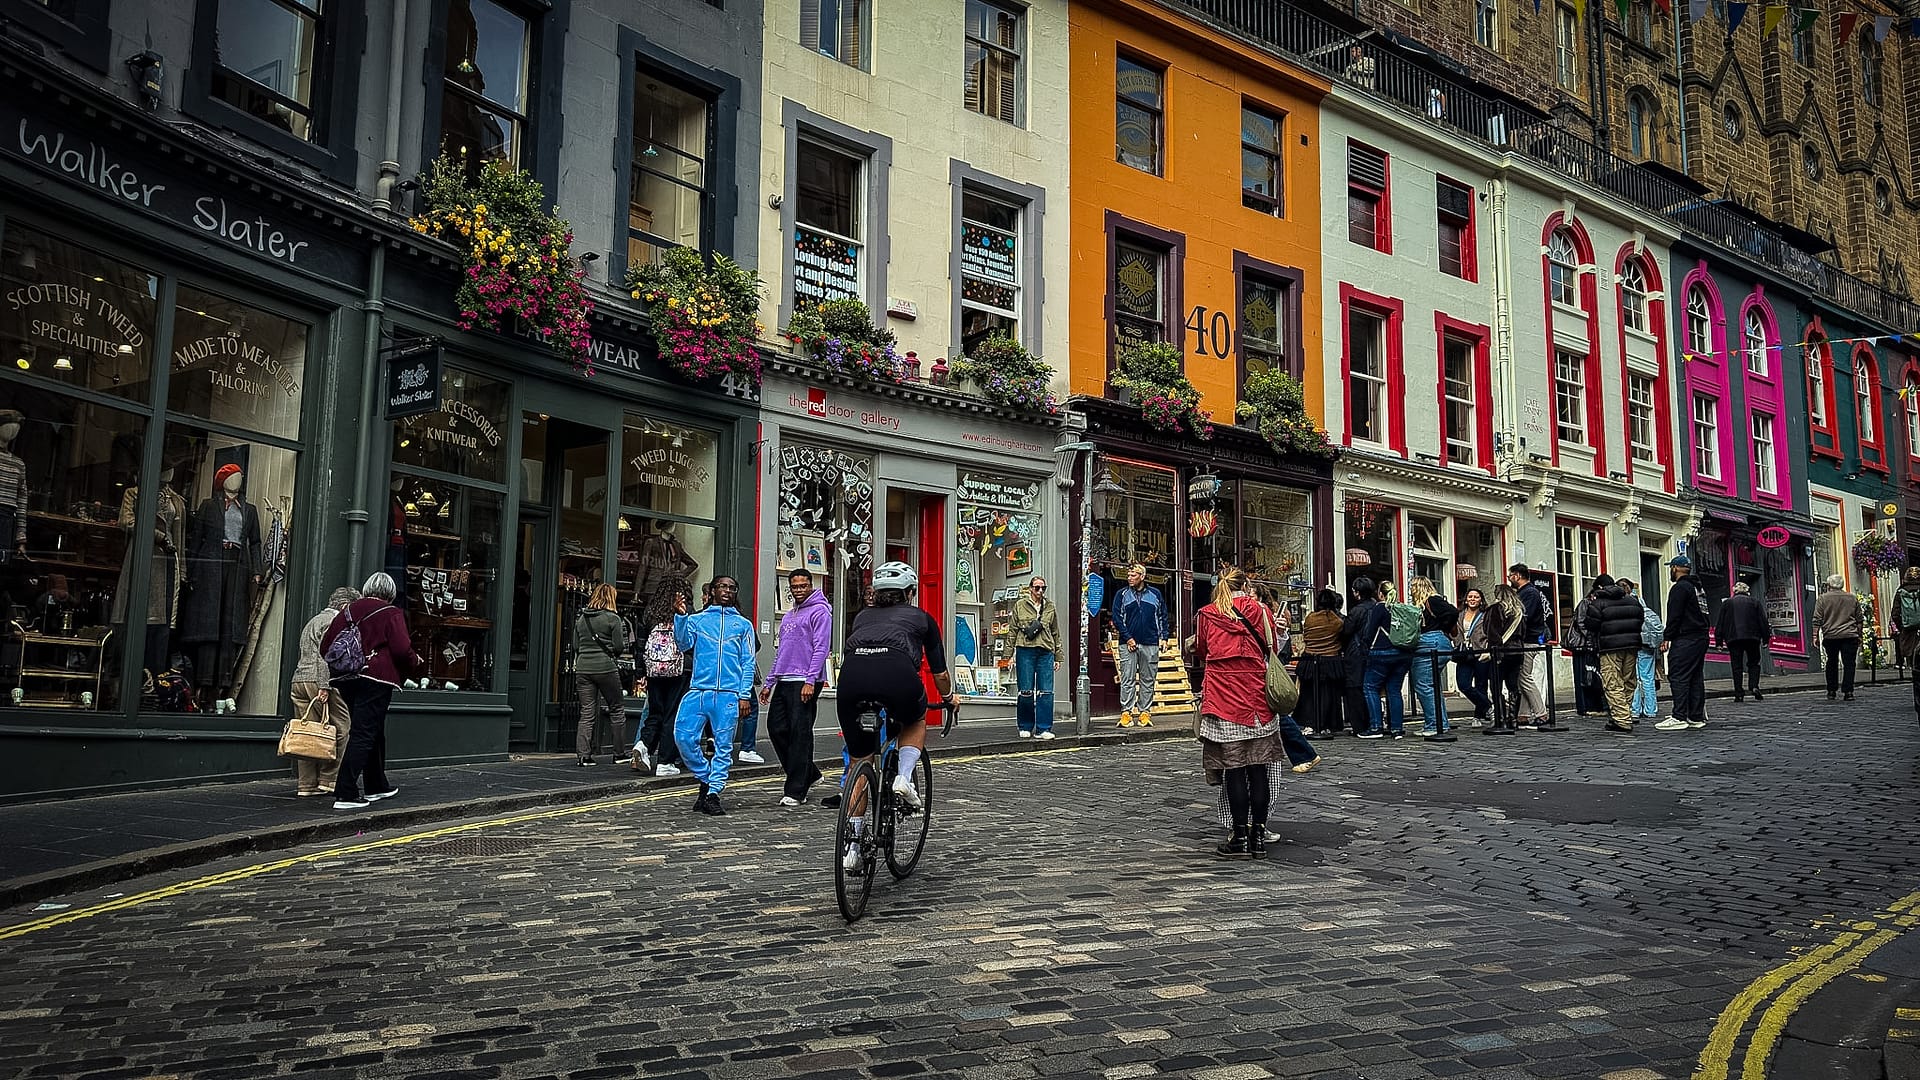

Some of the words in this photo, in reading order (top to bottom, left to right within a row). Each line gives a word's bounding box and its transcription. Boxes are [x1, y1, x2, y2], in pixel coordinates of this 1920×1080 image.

[19, 118, 165, 207] Walker
[192, 197, 309, 262] Slater
[794, 247, 827, 270] Loving
[828, 257, 854, 276] Local
[795, 278, 824, 298] Since
[804, 268, 824, 282] and
[824, 272, 857, 292] Design
[6, 283, 91, 311] SCOTTISH
[97, 298, 145, 348] TWEED
[72, 311, 85, 327] &
[31, 320, 119, 359] SPECIALITIES
[1185, 305, 1230, 360] 40
[174, 338, 216, 367] MADE
[216, 336, 238, 356] TO
[240, 340, 301, 399] MEASURE
[236, 362, 246, 374] &
[208, 369, 271, 399] TAILORING
[390, 393, 414, 406] Walker
[414, 390, 434, 402] Slater
[440, 398, 502, 447] ACCESSORIES
[448, 416, 458, 428] &
[789, 393, 808, 409] the
[808, 398, 826, 413] red
[828, 402, 855, 418] door
[860, 410, 900, 430] gallery
[426, 426, 477, 449] KNITWEAR
[630, 448, 666, 471] TWEED
[668, 464, 676, 474] &
[640, 472, 701, 492] CHILDRENSWEAR
[964, 480, 1002, 492] SUPPORT
[1004, 486, 1026, 496] LOCAL
[990, 494, 998, 504] &
[1110, 526, 1168, 554] MUSEUM
